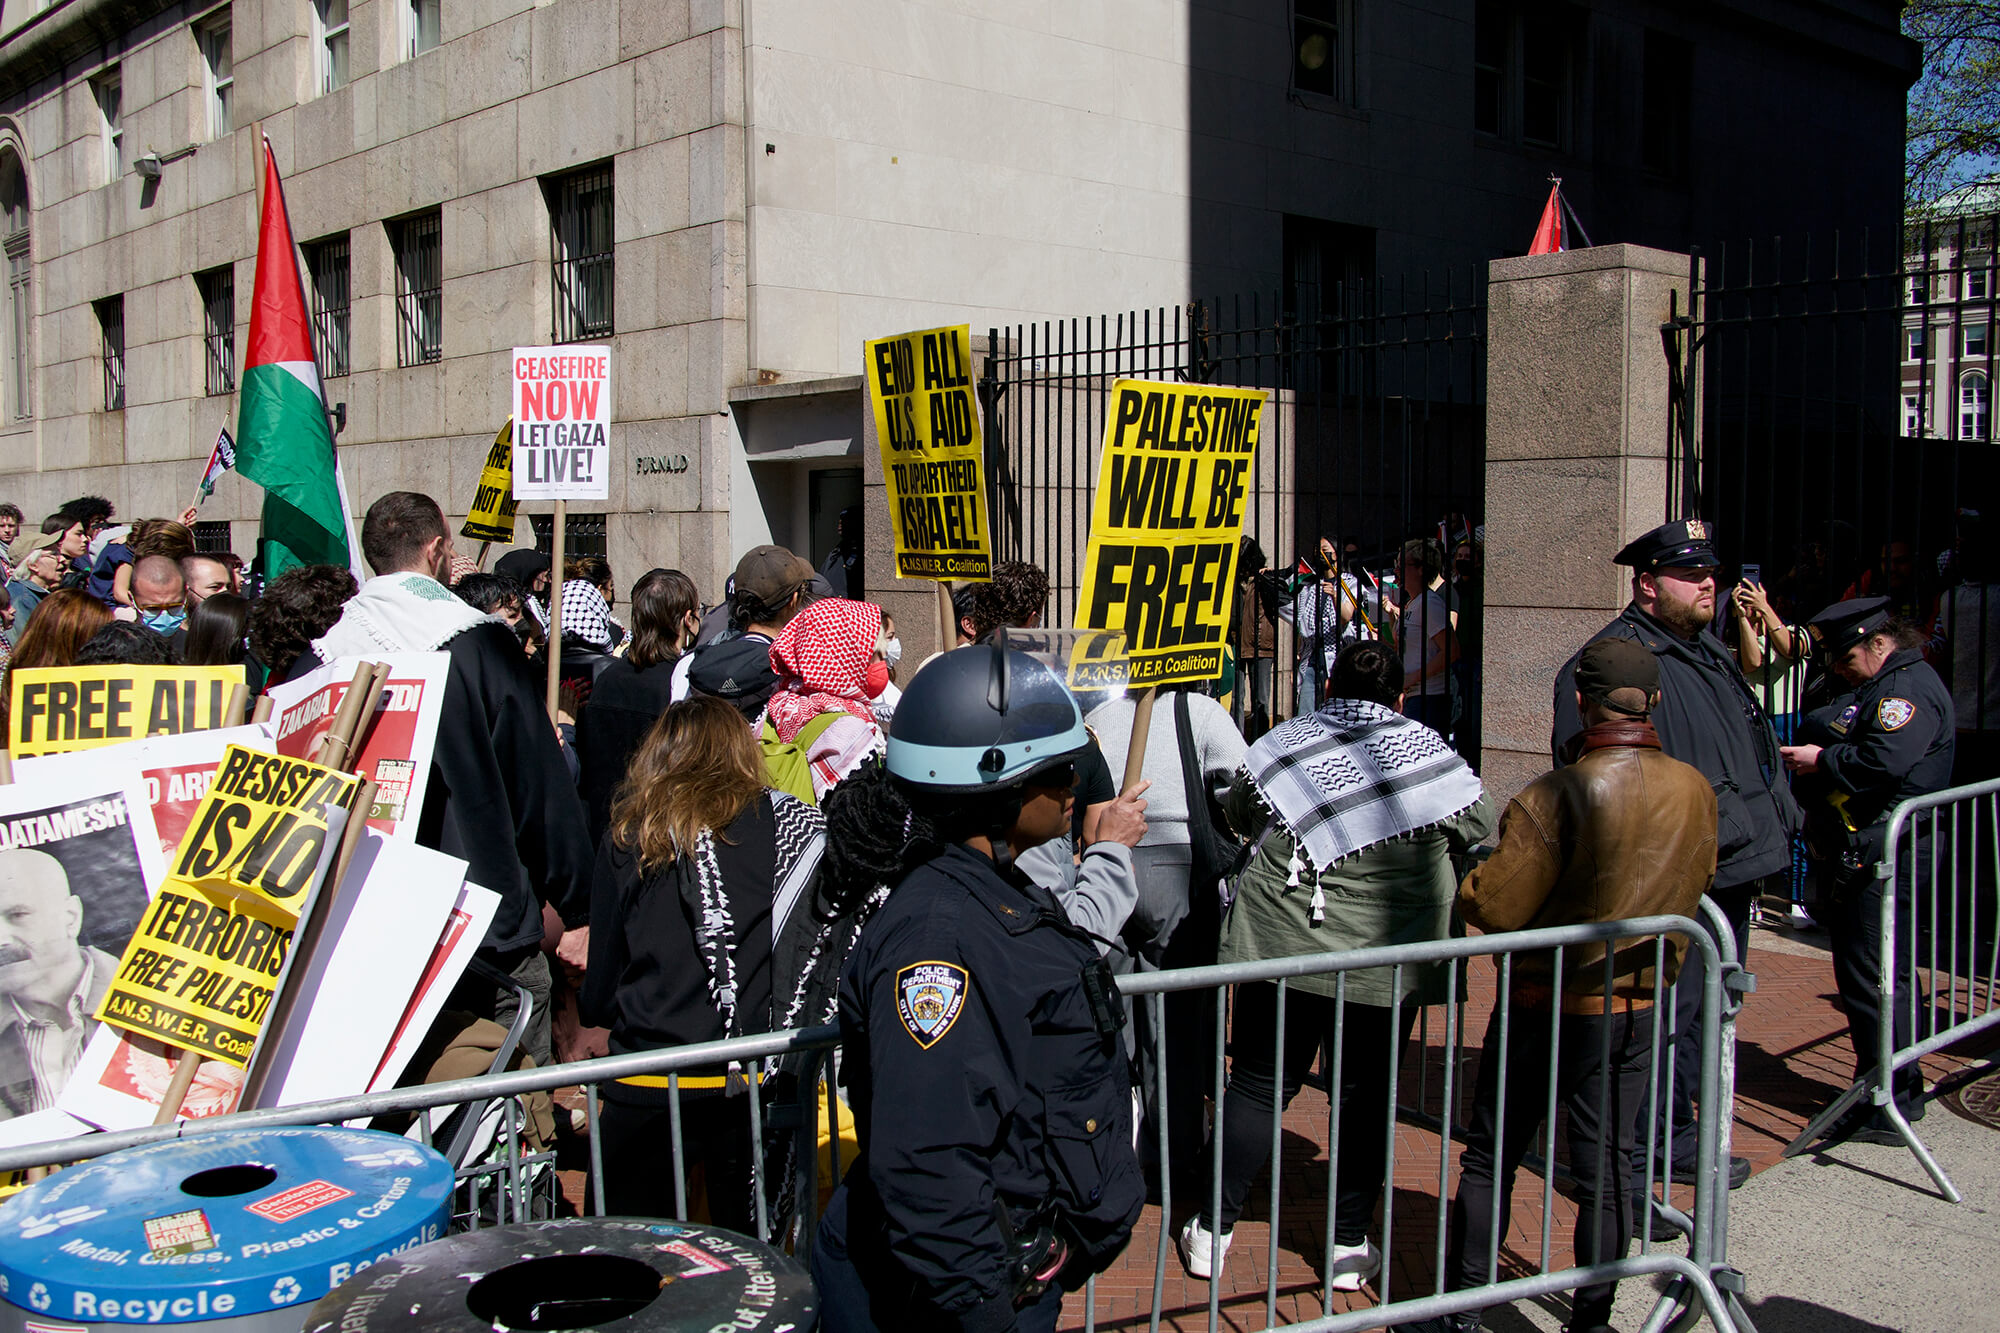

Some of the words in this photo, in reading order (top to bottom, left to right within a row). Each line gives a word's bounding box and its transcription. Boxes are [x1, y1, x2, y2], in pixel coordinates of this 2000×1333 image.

[515, 356, 607, 380] CEASEFIRE
[874, 338, 915, 397] END
[922, 331, 969, 391] ALL
[521, 381, 600, 421] NOW
[518, 424, 550, 447] LET
[554, 423, 606, 447] GAZA
[884, 396, 923, 451] U.S.
[929, 390, 972, 448] AID
[1114, 389, 1263, 453] PALESTINE
[528, 448, 594, 484] LIVE!
[635, 454, 689, 475] FURNALD
[892, 464, 909, 495] TO
[909, 459, 977, 495] APARTHEID
[472, 484, 502, 514] NOT
[1109, 454, 1199, 529] WILL
[1205, 458, 1249, 528] BE
[899, 495, 980, 550] ISRAEL!
[947, 558, 987, 574] Coalition
[1088, 543, 1234, 650] FREE!
[1165, 654, 1217, 674] Coalition
[20, 679, 133, 743] FREE
[148, 679, 224, 737] ALL
[278, 689, 331, 741] ZAKARIA
[177, 798, 251, 877] IS
[120, 948, 187, 993] FREE
[901, 974, 963, 989] DEPARTMENT
[914, 966, 950, 976] POLICE
[108, 995, 209, 1044] A.N.S.W.E.R.
[900, 998, 912, 1020] CITY
[908, 1020, 919, 1032] OF
[931, 1018, 949, 1037] NEW
[946, 995, 962, 1019] YORK
[258, 1184, 326, 1210] Decolonize
[274, 1203, 307, 1216] This
[304, 1190, 341, 1205] Place
[60, 1238, 128, 1266] Metal,
[241, 1224, 340, 1258] Plastic
[337, 1217, 364, 1229] &
[357, 1176, 412, 1218] Cartons
[73, 1290, 236, 1323] Recycle
